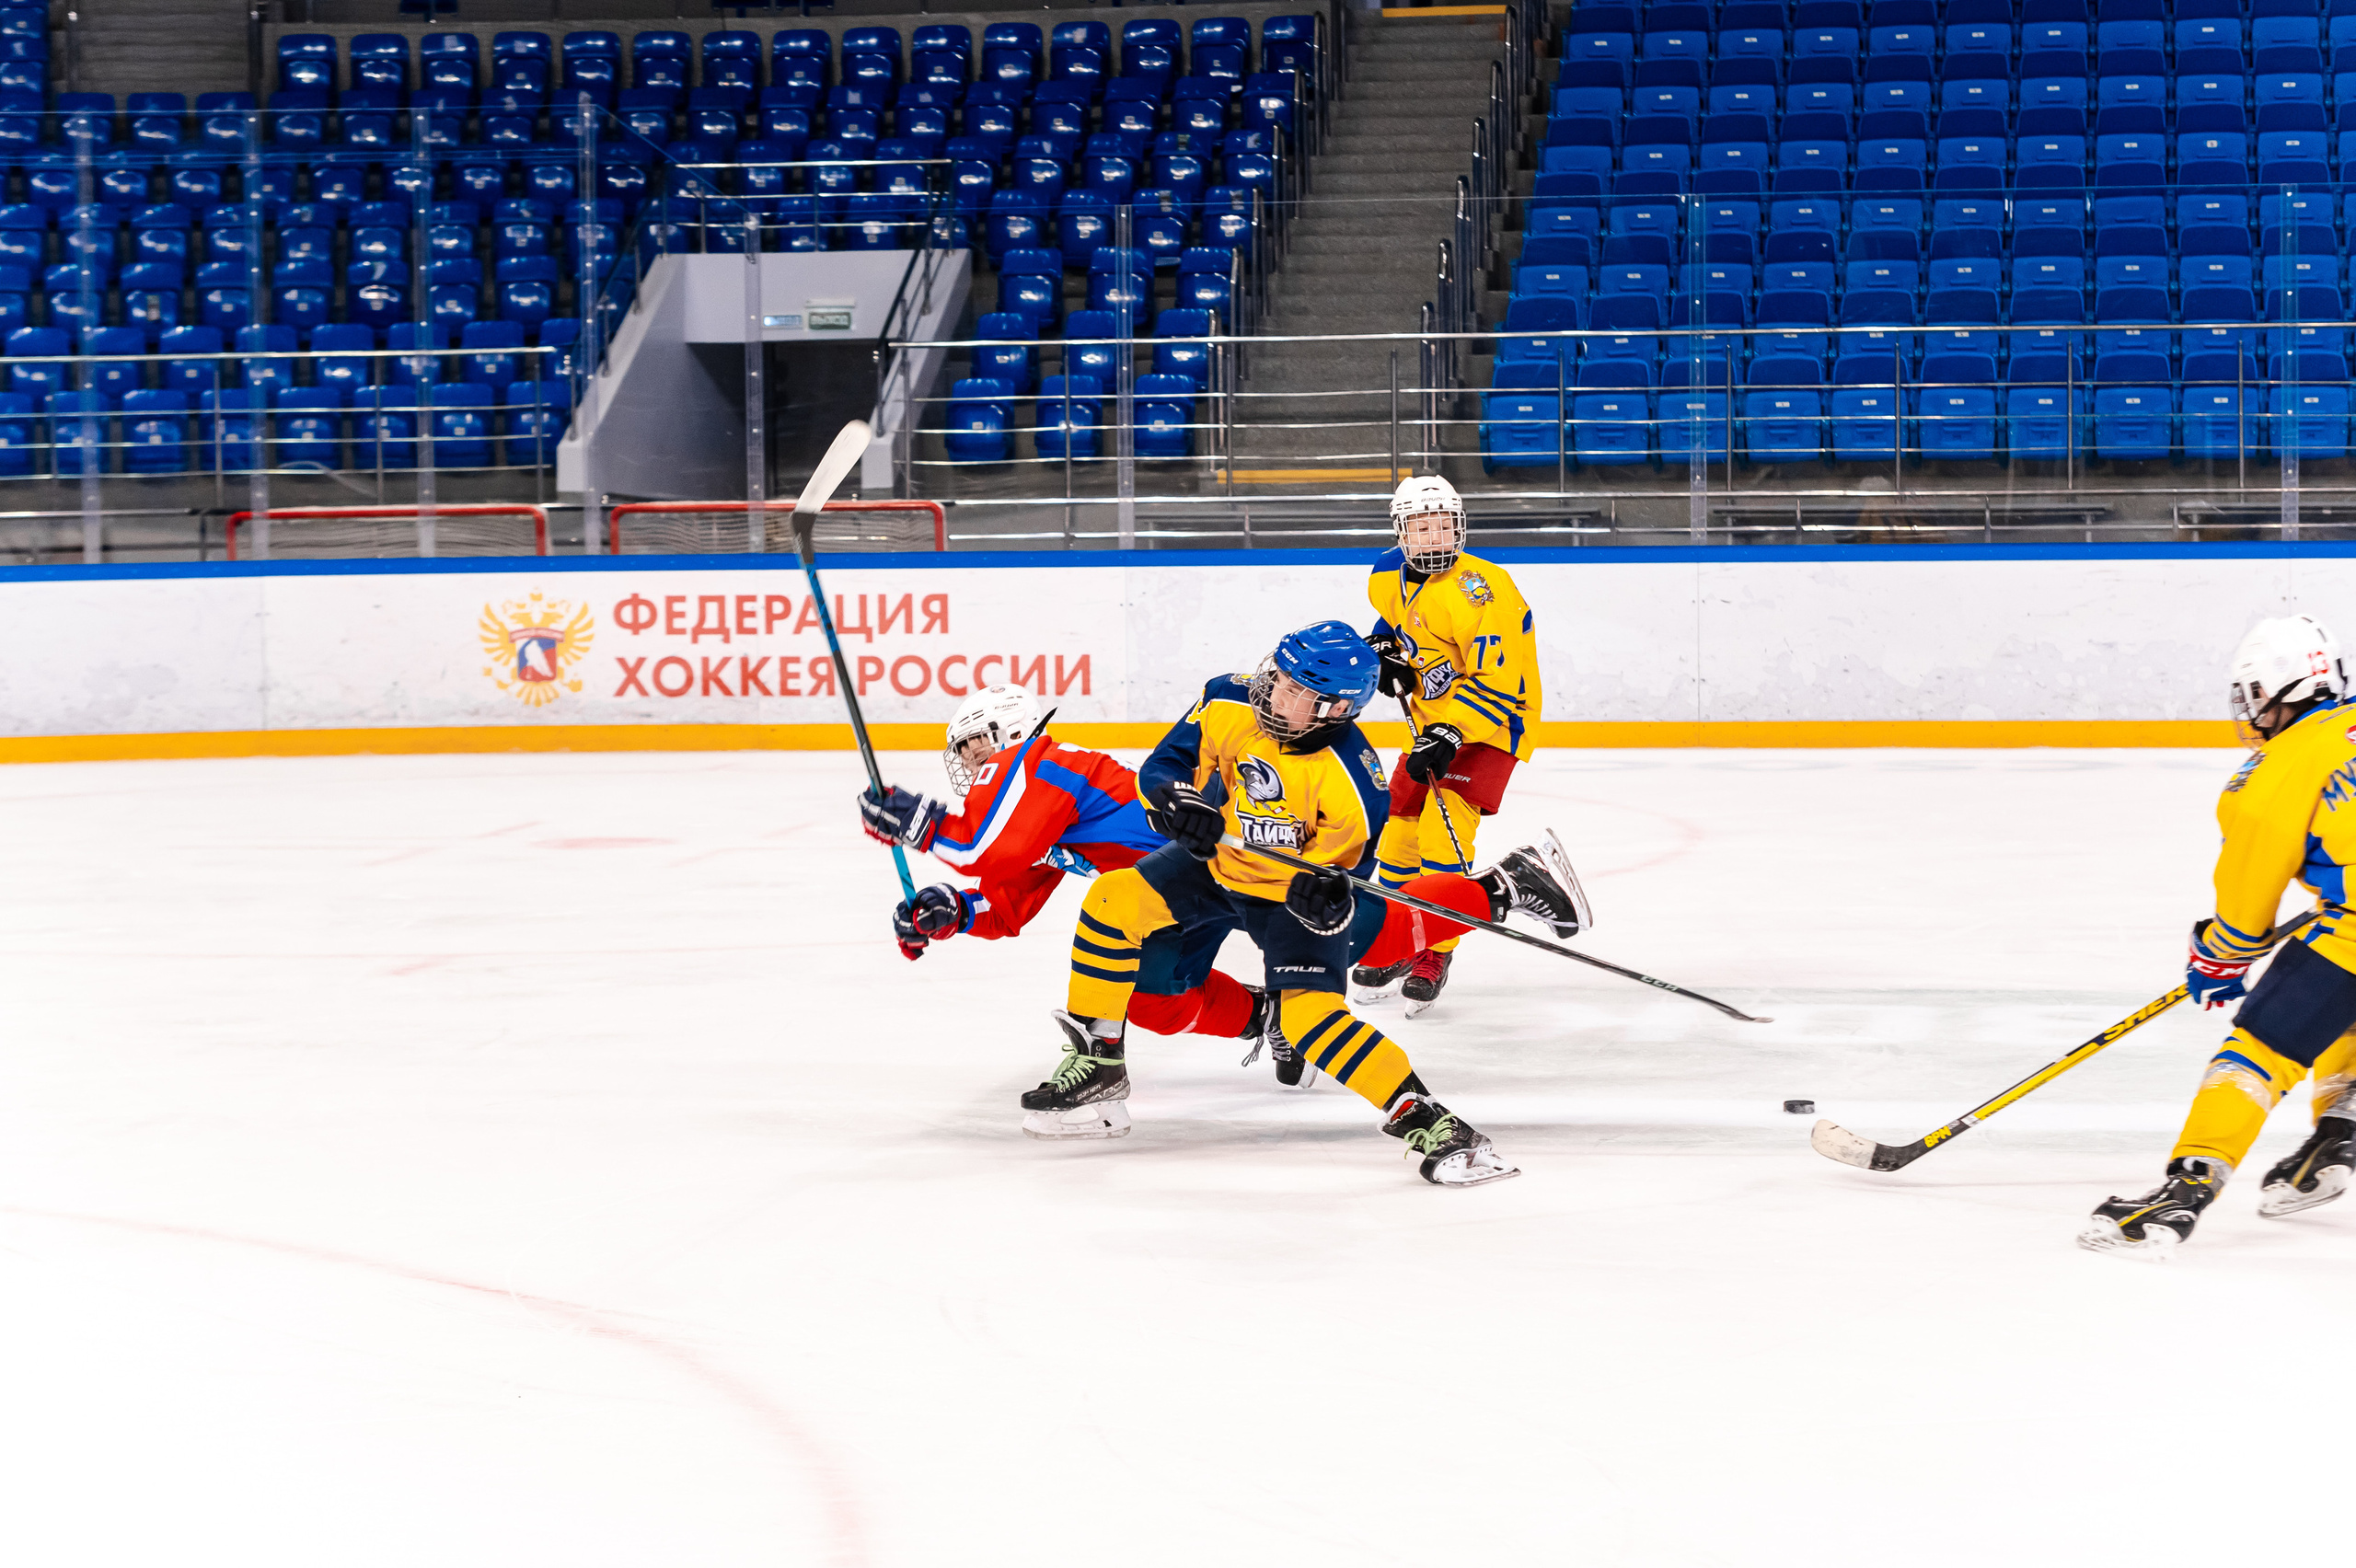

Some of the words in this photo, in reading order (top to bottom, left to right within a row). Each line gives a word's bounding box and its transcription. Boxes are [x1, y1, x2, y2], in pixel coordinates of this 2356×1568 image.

[613, 593, 949, 644] ФЕДЕРАЦИЯ
[612, 654, 835, 698] ХОККЕЯ
[857, 654, 1091, 698] РОССИИ
[1273, 965, 1326, 974] TRUE
